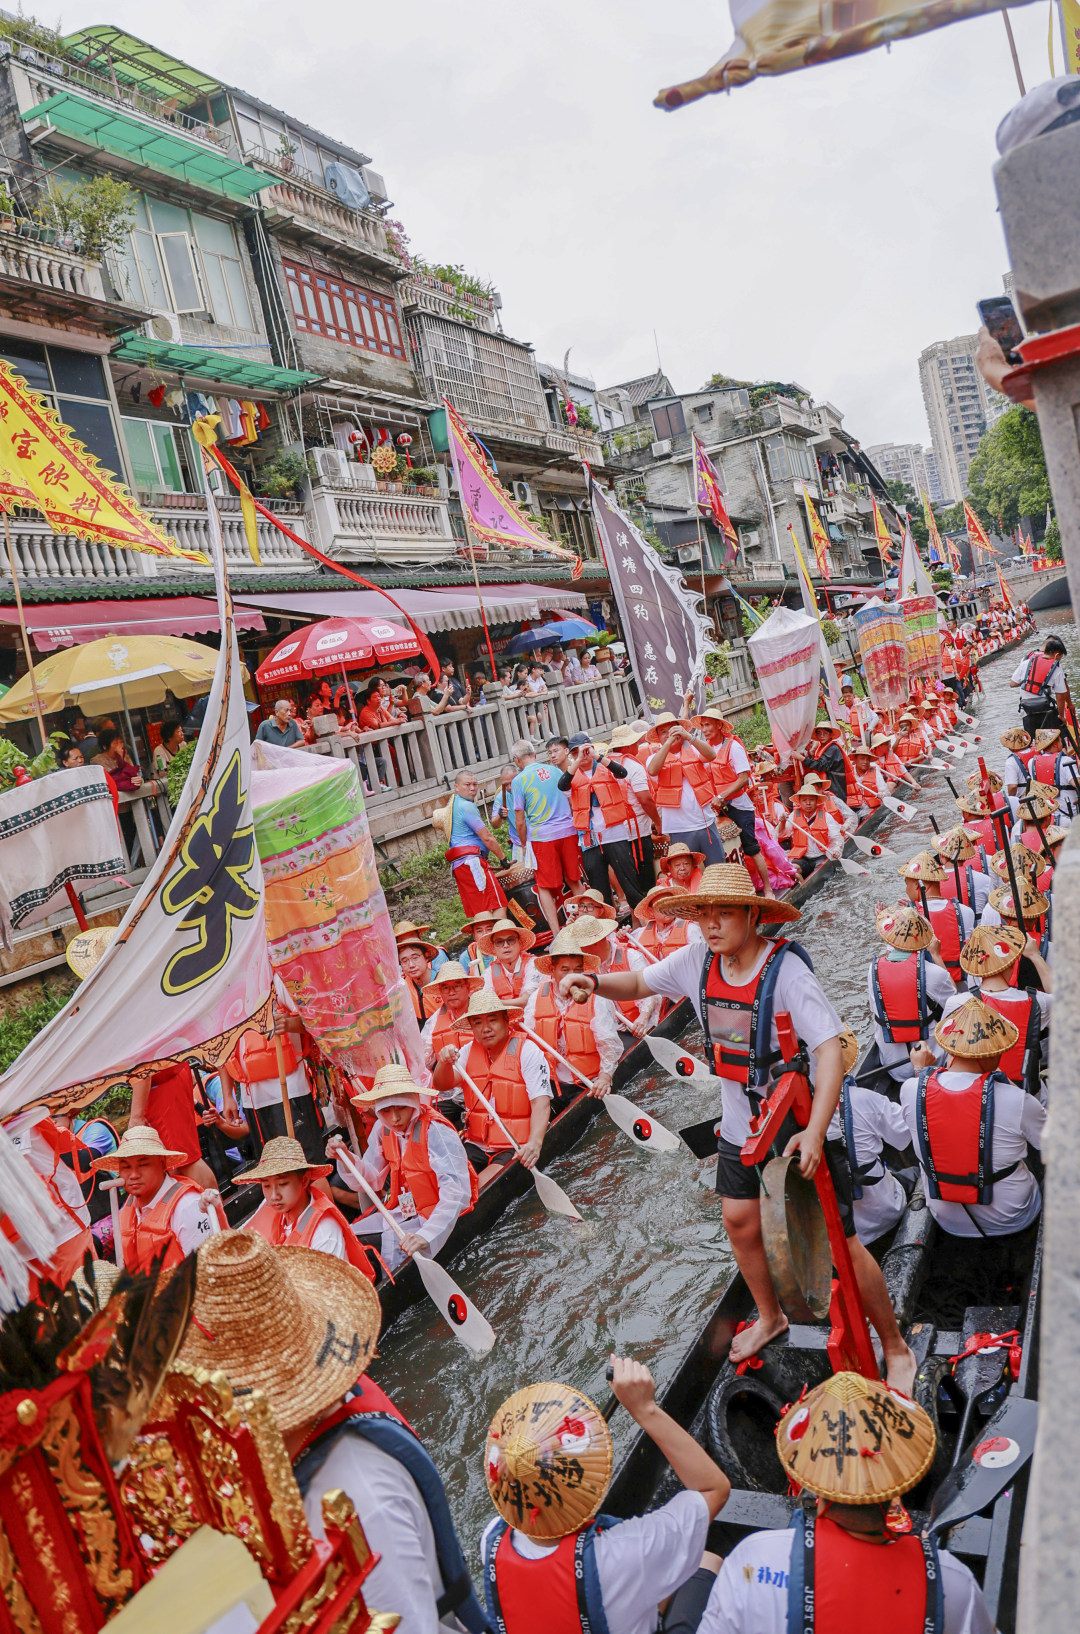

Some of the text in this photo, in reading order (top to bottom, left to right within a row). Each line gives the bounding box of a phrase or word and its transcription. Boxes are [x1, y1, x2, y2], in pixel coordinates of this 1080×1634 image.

[311, 649, 365, 666] 东方植物饮品世家
[705, 953, 714, 971] JUST
[760, 953, 776, 981] JUST GO
[701, 988, 707, 1000] GO
[714, 1000, 730, 1008] JUST
[751, 999, 760, 1031] JUST GO
[748, 1048, 756, 1078] JUST GO
[921, 1089, 926, 1098] GO
[981, 1094, 987, 1105] GO
[923, 1132, 930, 1142] GO
[978, 1138, 984, 1149] GO
[928, 1156, 936, 1172] JUST
[804, 1531, 815, 1548] GO
[922, 1538, 937, 1580] UST GO
[489, 1564, 497, 1582] GO
[574, 1560, 584, 1579] GO
[804, 1586, 815, 1622] JUST
